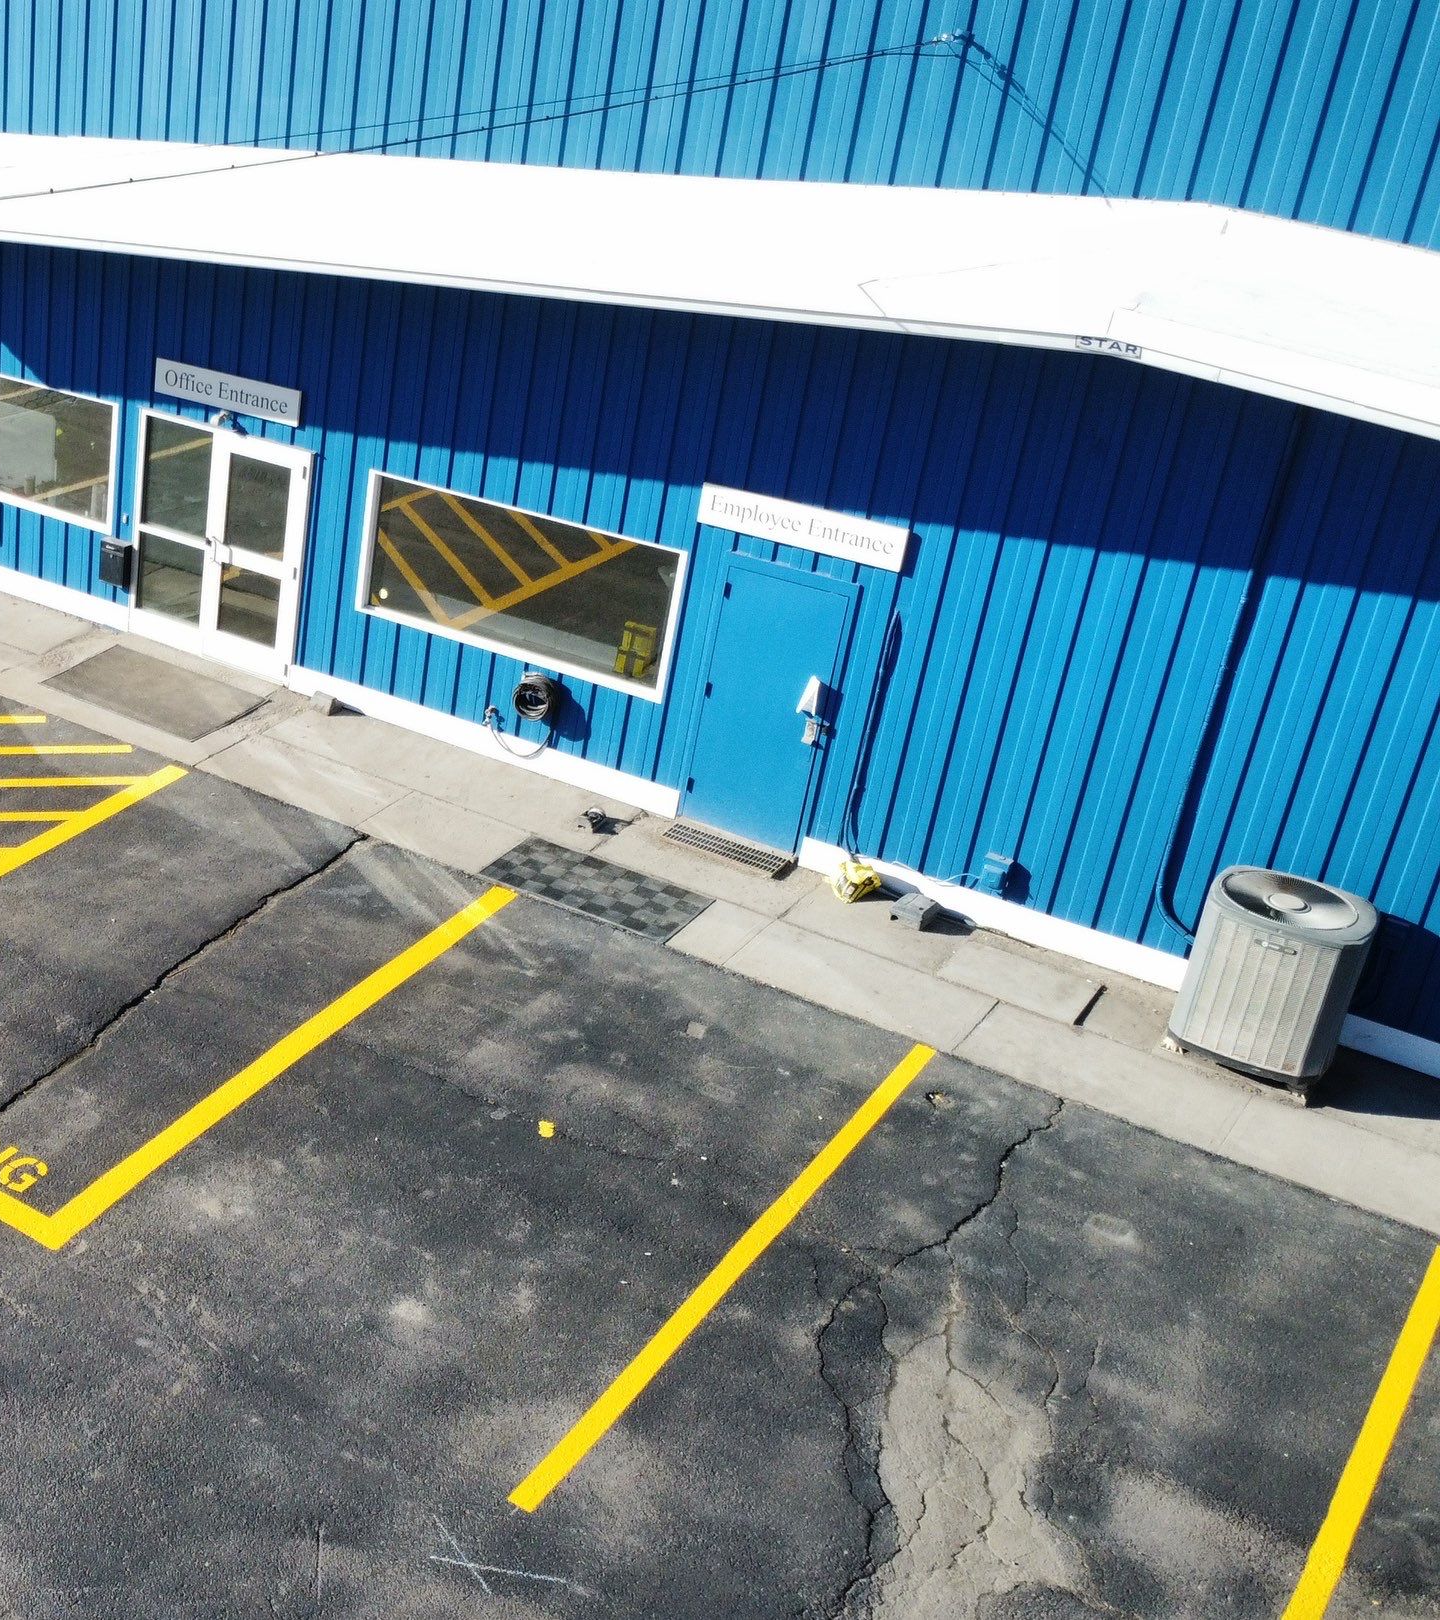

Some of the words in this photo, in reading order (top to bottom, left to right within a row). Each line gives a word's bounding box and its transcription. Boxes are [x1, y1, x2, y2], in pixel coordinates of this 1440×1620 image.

[1080, 336, 1138, 354] STAR
[164, 369, 213, 396] Office
[218, 381, 288, 414] Entrance
[710, 494, 802, 532] Employee
[807, 518, 894, 555] Entrance
